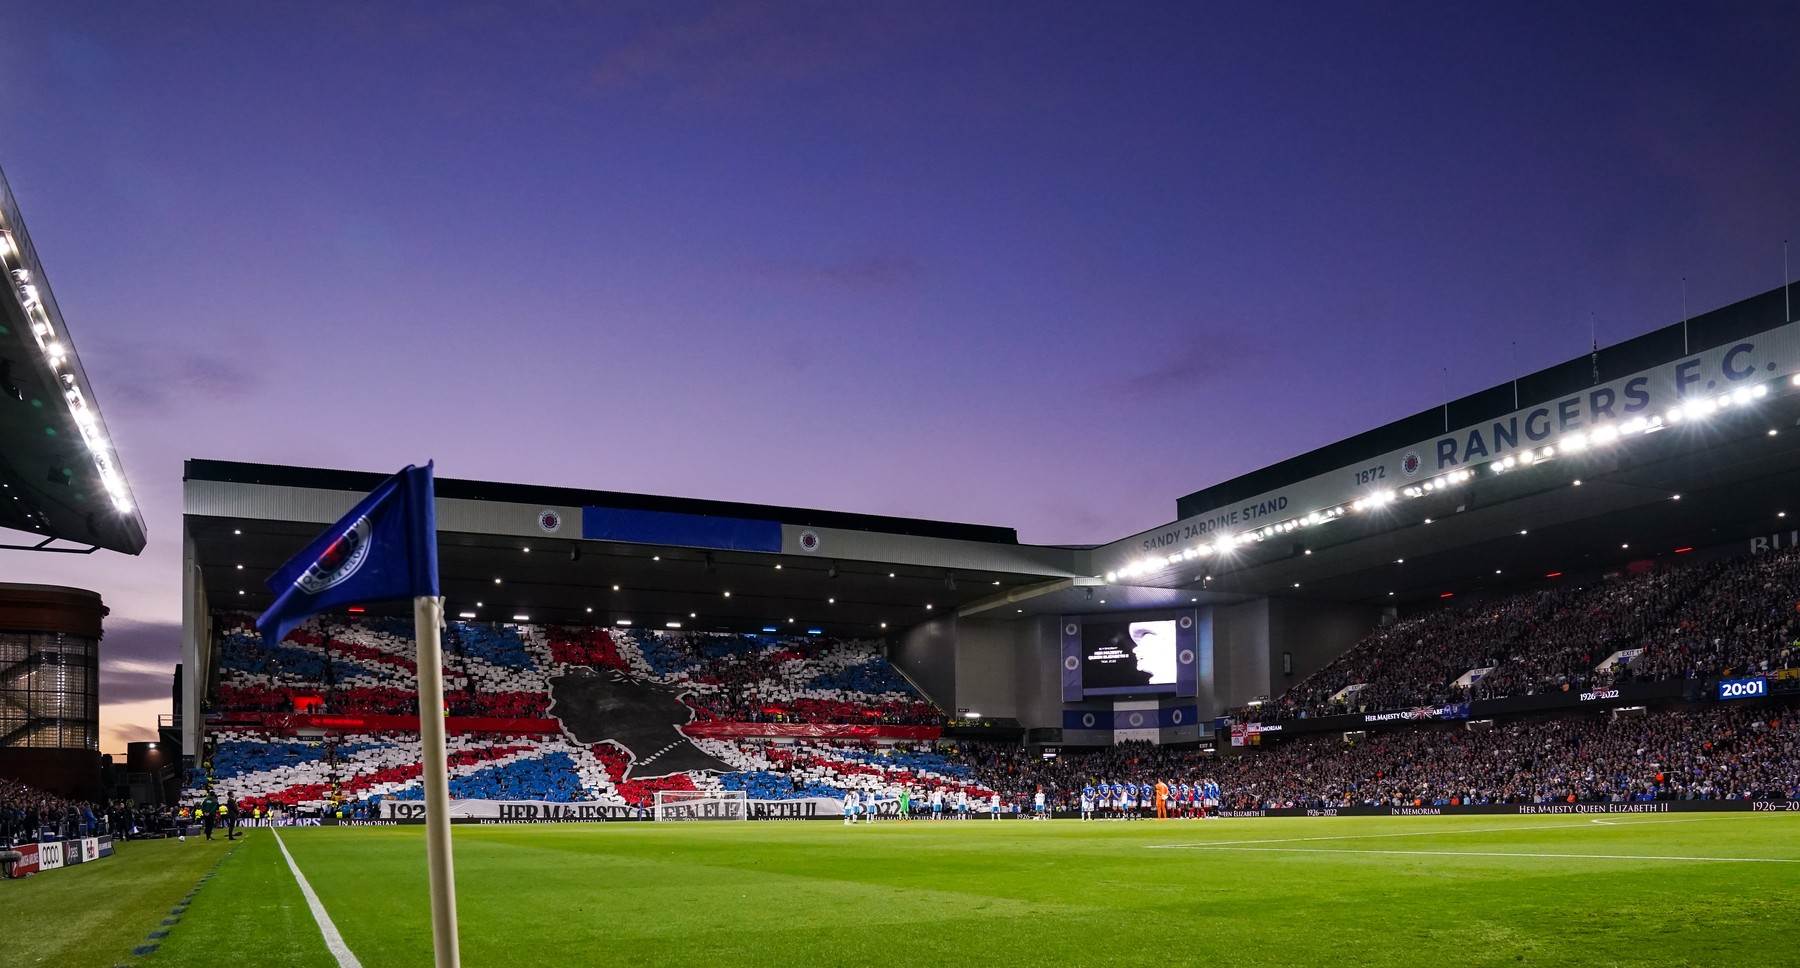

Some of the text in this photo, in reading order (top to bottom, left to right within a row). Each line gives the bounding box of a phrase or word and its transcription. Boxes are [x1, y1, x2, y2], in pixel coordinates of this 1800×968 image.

[1437, 377, 1650, 469] RANGERS
[1675, 343, 1777, 400] F.C.
[1355, 465, 1386, 485] 1872
[1143, 496, 1288, 552] SANDY JARDINE STAND
[1722, 680, 1763, 697] 20:01
[1365, 714, 1377, 722] HER
[1377, 712, 1401, 720] MAJESTY
[387, 803, 426, 819] 192
[499, 804, 539, 819] HER
[858, 800, 901, 816] 222
[1519, 803, 1669, 815] HER MAJESTY QUEEN ELIZABETH II
[1752, 801, 1800, 812] 1926—20
